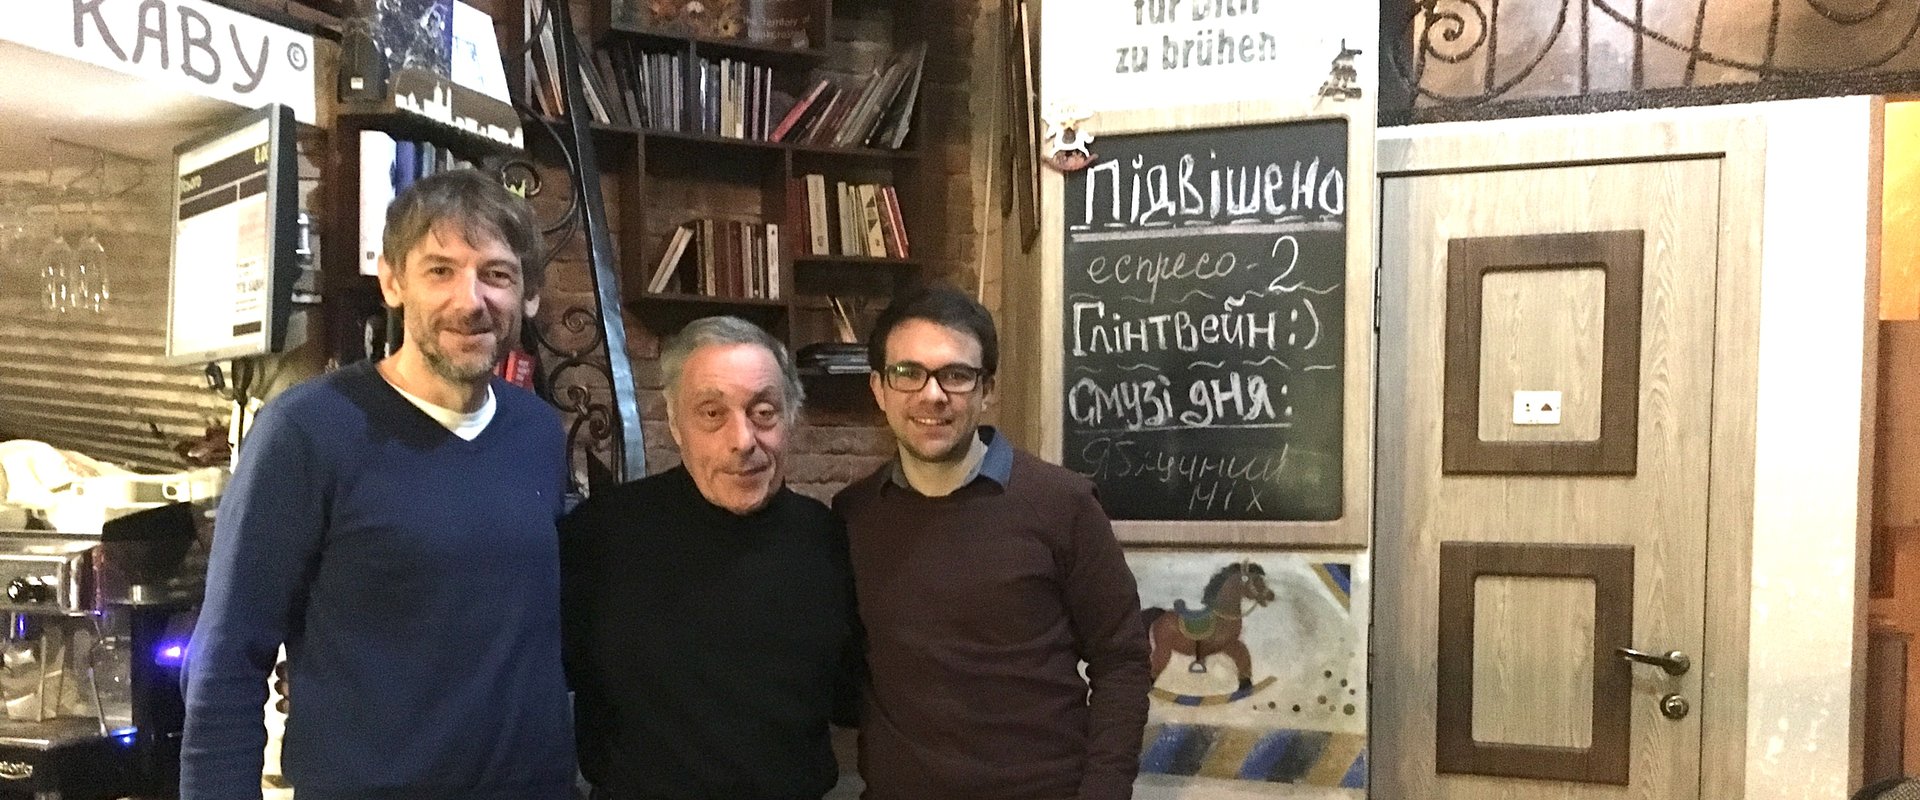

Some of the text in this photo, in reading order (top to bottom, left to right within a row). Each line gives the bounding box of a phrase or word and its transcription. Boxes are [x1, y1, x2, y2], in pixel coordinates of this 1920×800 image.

[1115, 29, 1277, 74] zu brühen
[1085, 150, 1344, 226] Підвішено
